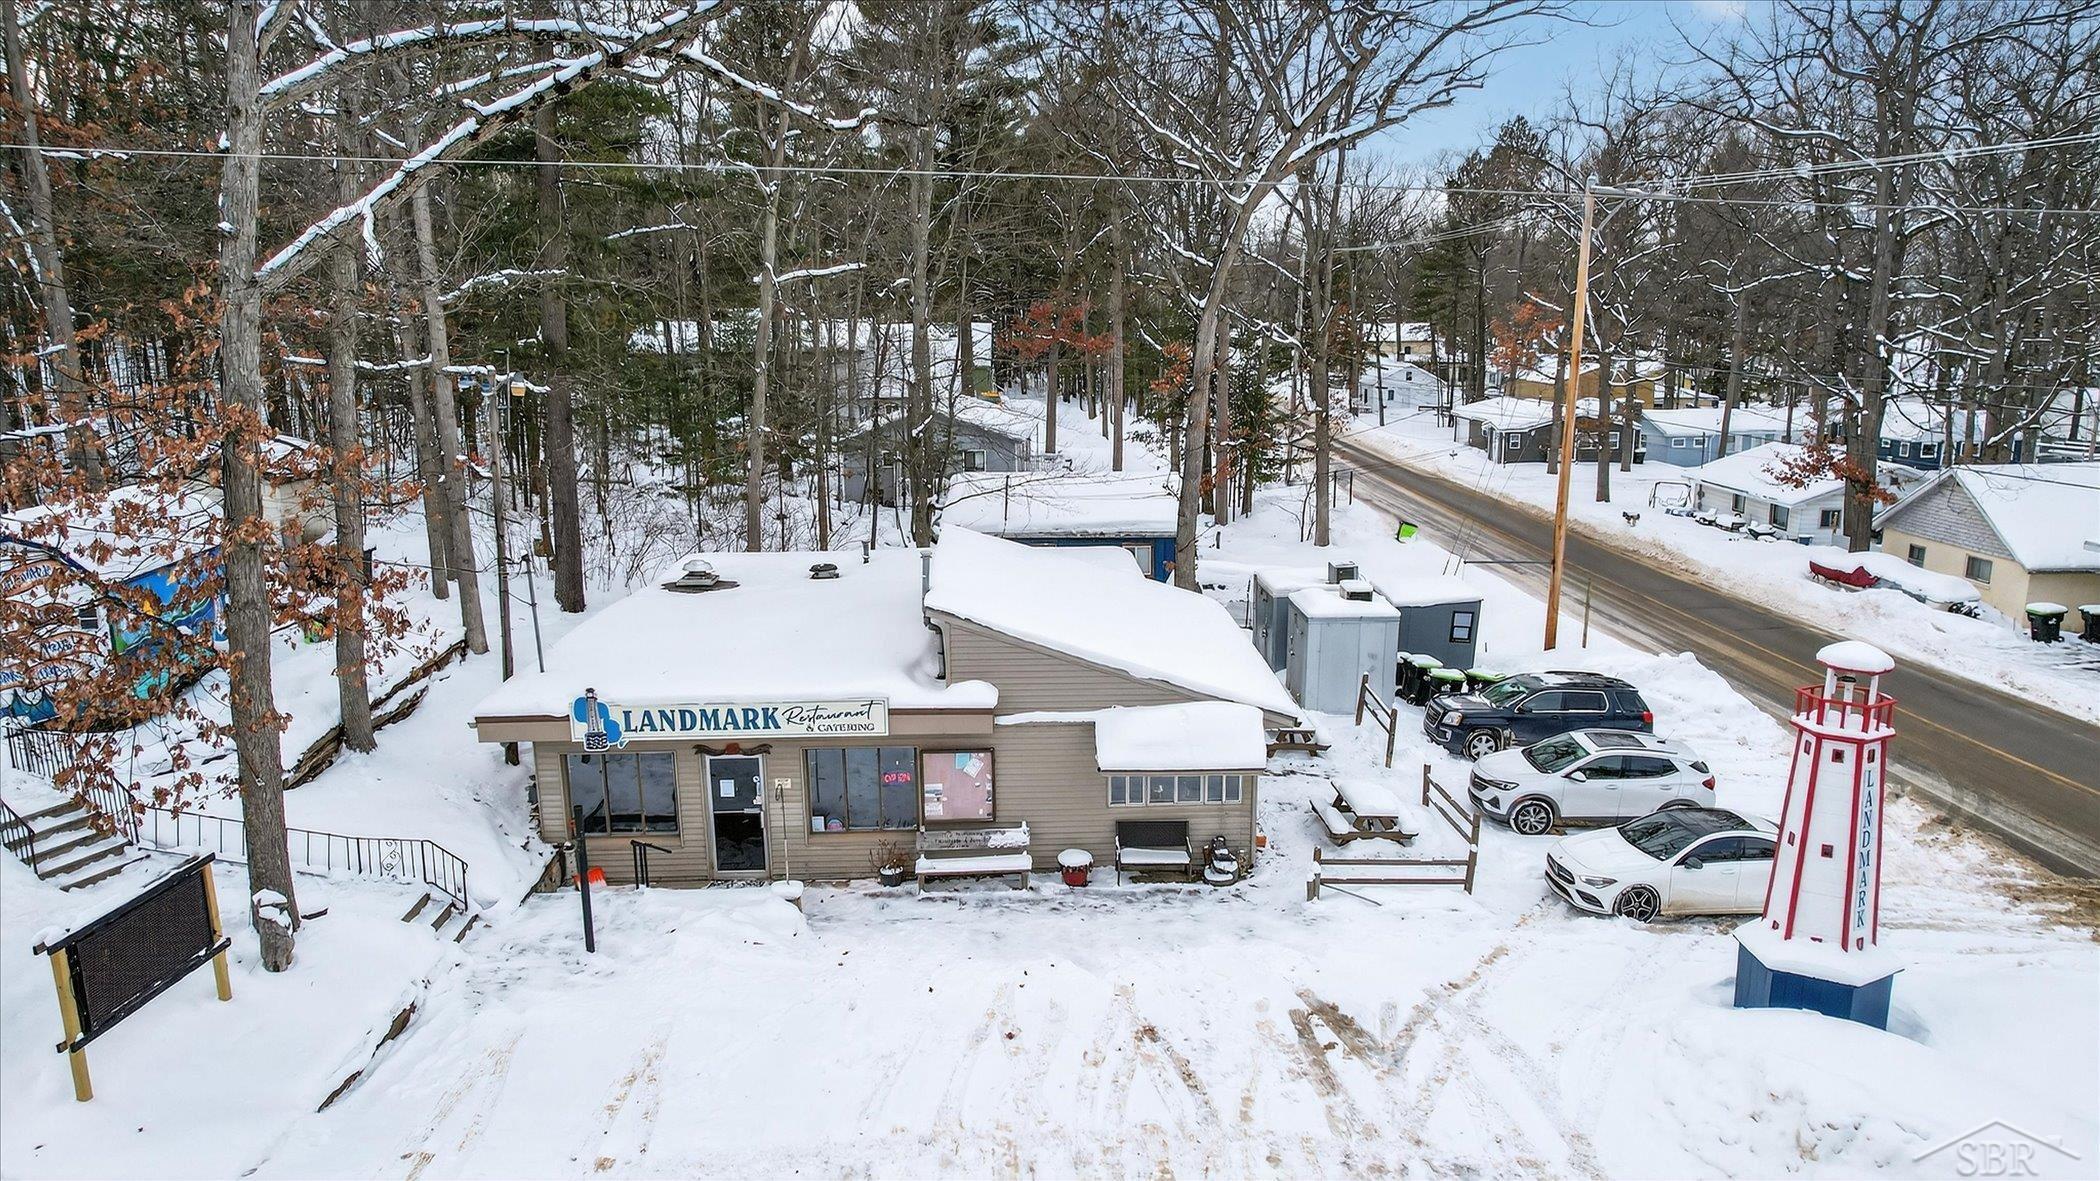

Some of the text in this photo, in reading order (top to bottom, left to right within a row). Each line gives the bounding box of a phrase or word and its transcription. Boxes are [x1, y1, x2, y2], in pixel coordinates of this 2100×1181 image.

[622, 707, 782, 733] LANDMARK
[782, 700, 882, 725] Restaurant
[806, 722, 875, 732] & CATERING
[1856, 770, 1874, 928] LANDMARK
